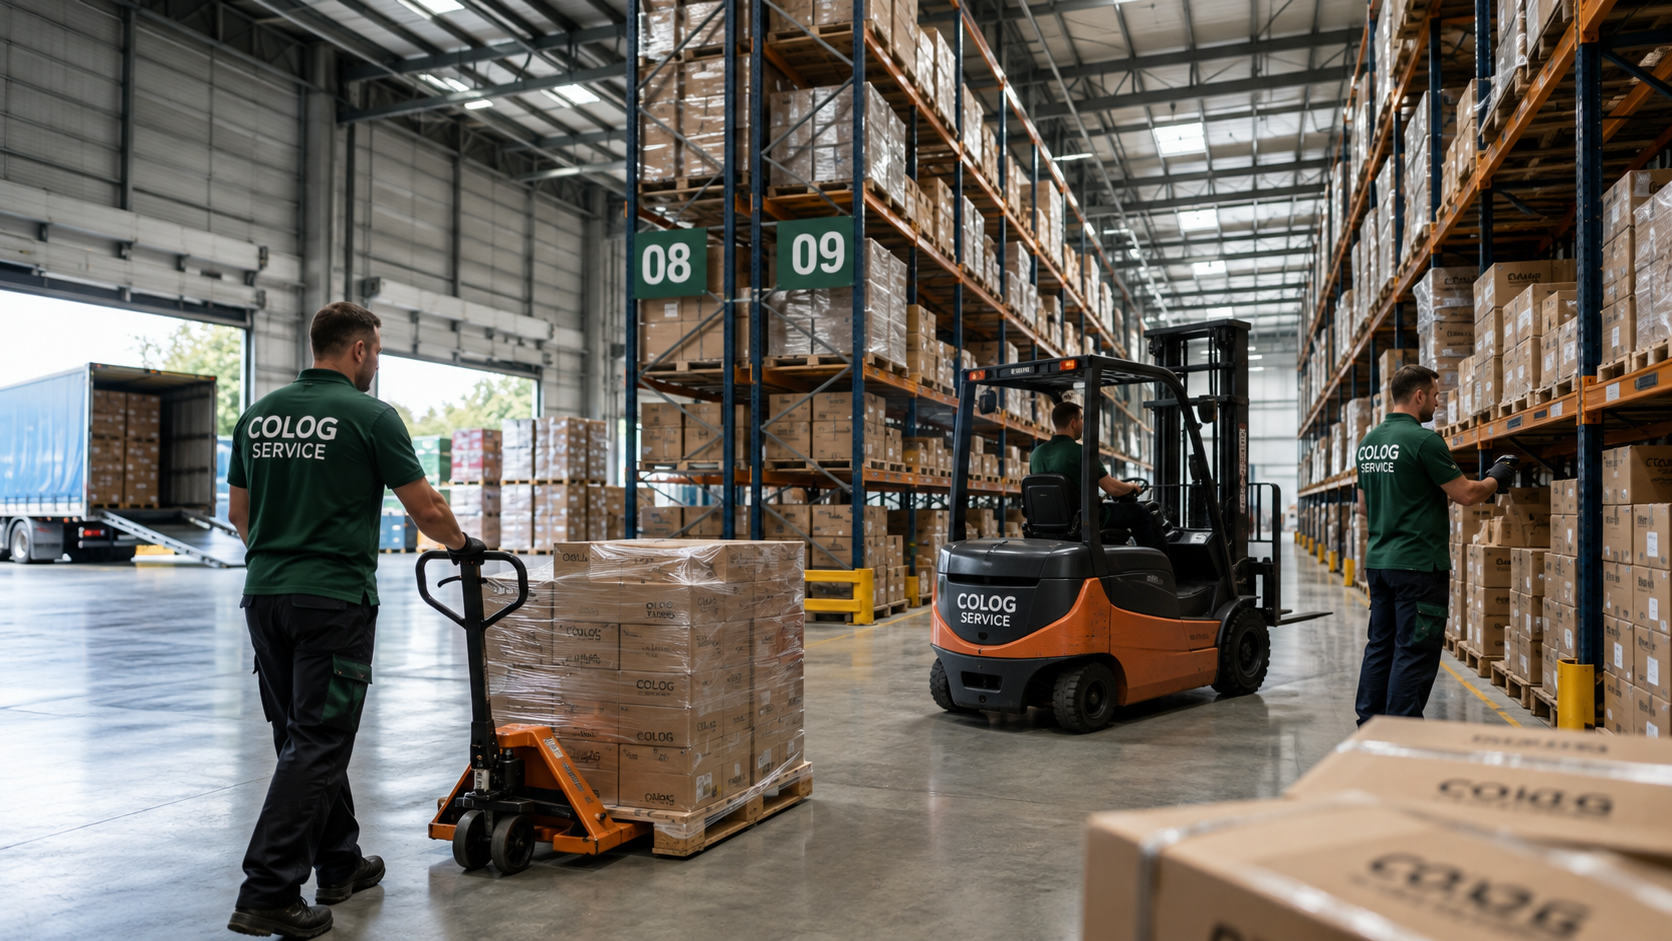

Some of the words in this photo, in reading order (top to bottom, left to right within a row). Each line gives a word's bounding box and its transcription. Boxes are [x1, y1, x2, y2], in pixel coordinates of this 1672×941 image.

[792, 231, 845, 276] 09
[641, 242, 692, 285] 08
[248, 414, 339, 440] COLOG
[253, 442, 326, 460] SERVICE
[1357, 443, 1400, 461] COLOG
[1360, 461, 1395, 474] SERVICE
[957, 592, 1017, 614] COLOG
[960, 611, 1011, 627] SERVICE
[636, 679, 675, 692] COLOG
[636, 731, 675, 743] COLOG
